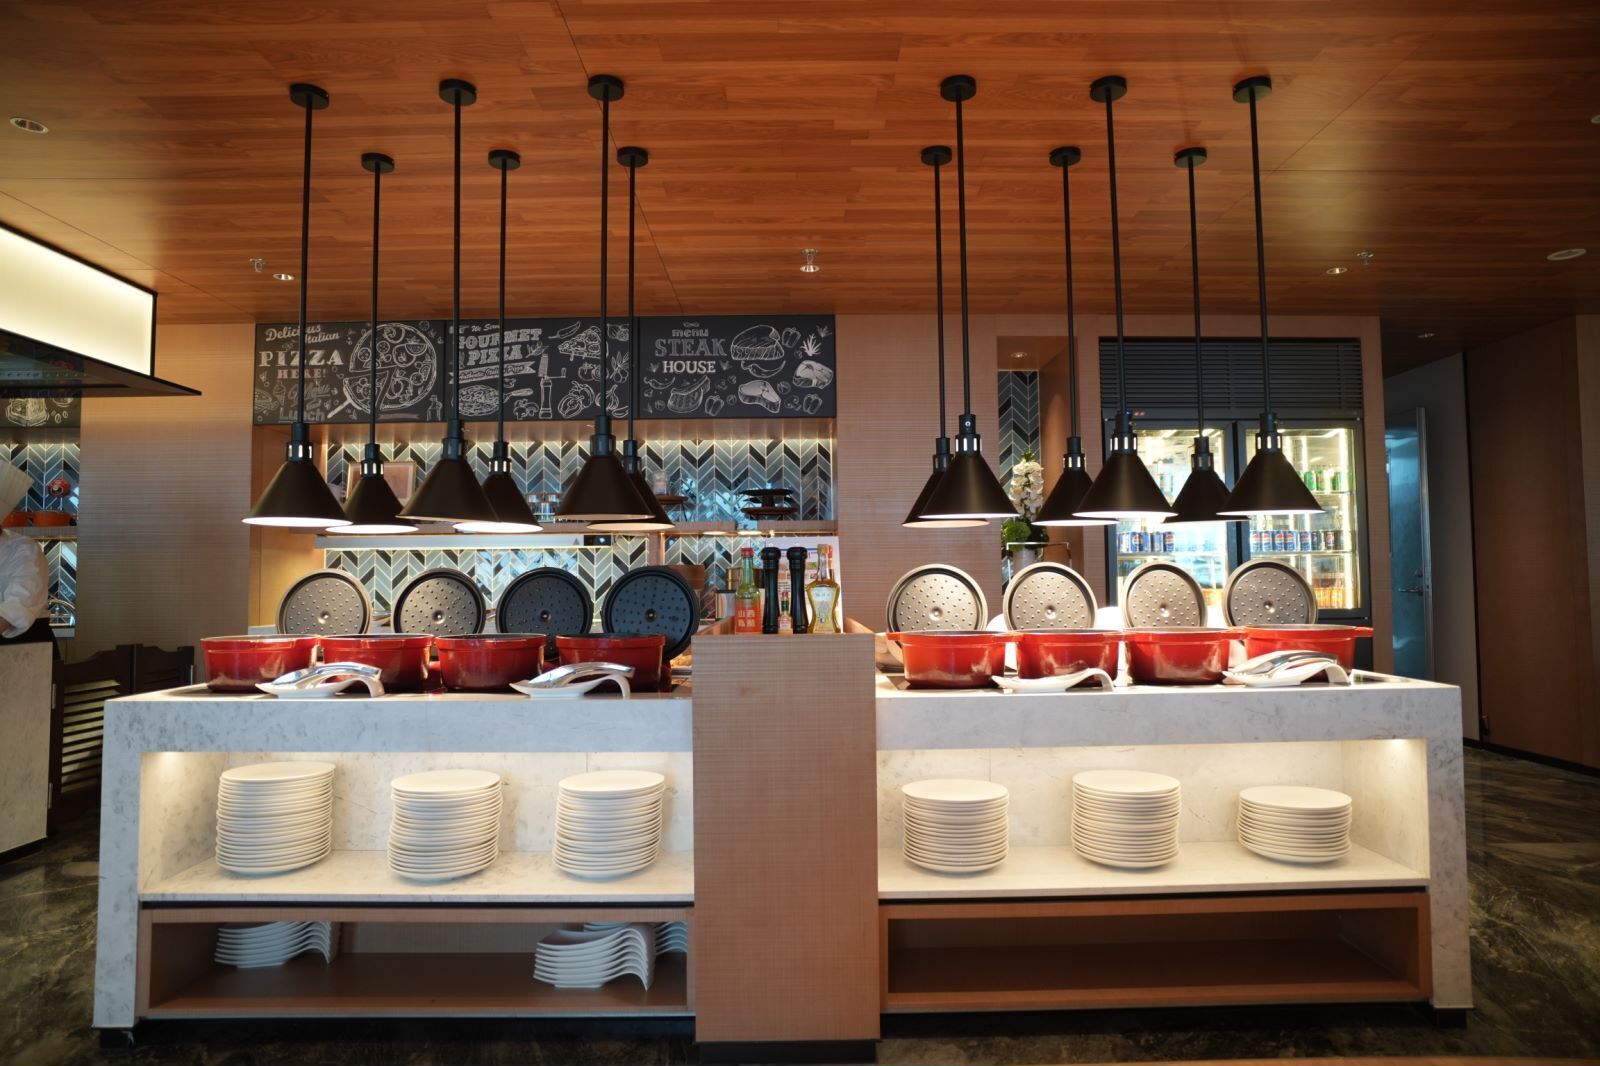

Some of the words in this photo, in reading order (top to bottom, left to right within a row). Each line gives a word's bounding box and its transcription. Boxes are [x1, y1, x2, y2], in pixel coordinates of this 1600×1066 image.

[265, 324, 321, 341] Delicius
[654, 338, 728, 357] STEAK
[258, 349, 345, 367] PIZZA
[276, 368, 327, 379] HERE!
[662, 360, 717, 374] HOUSE
